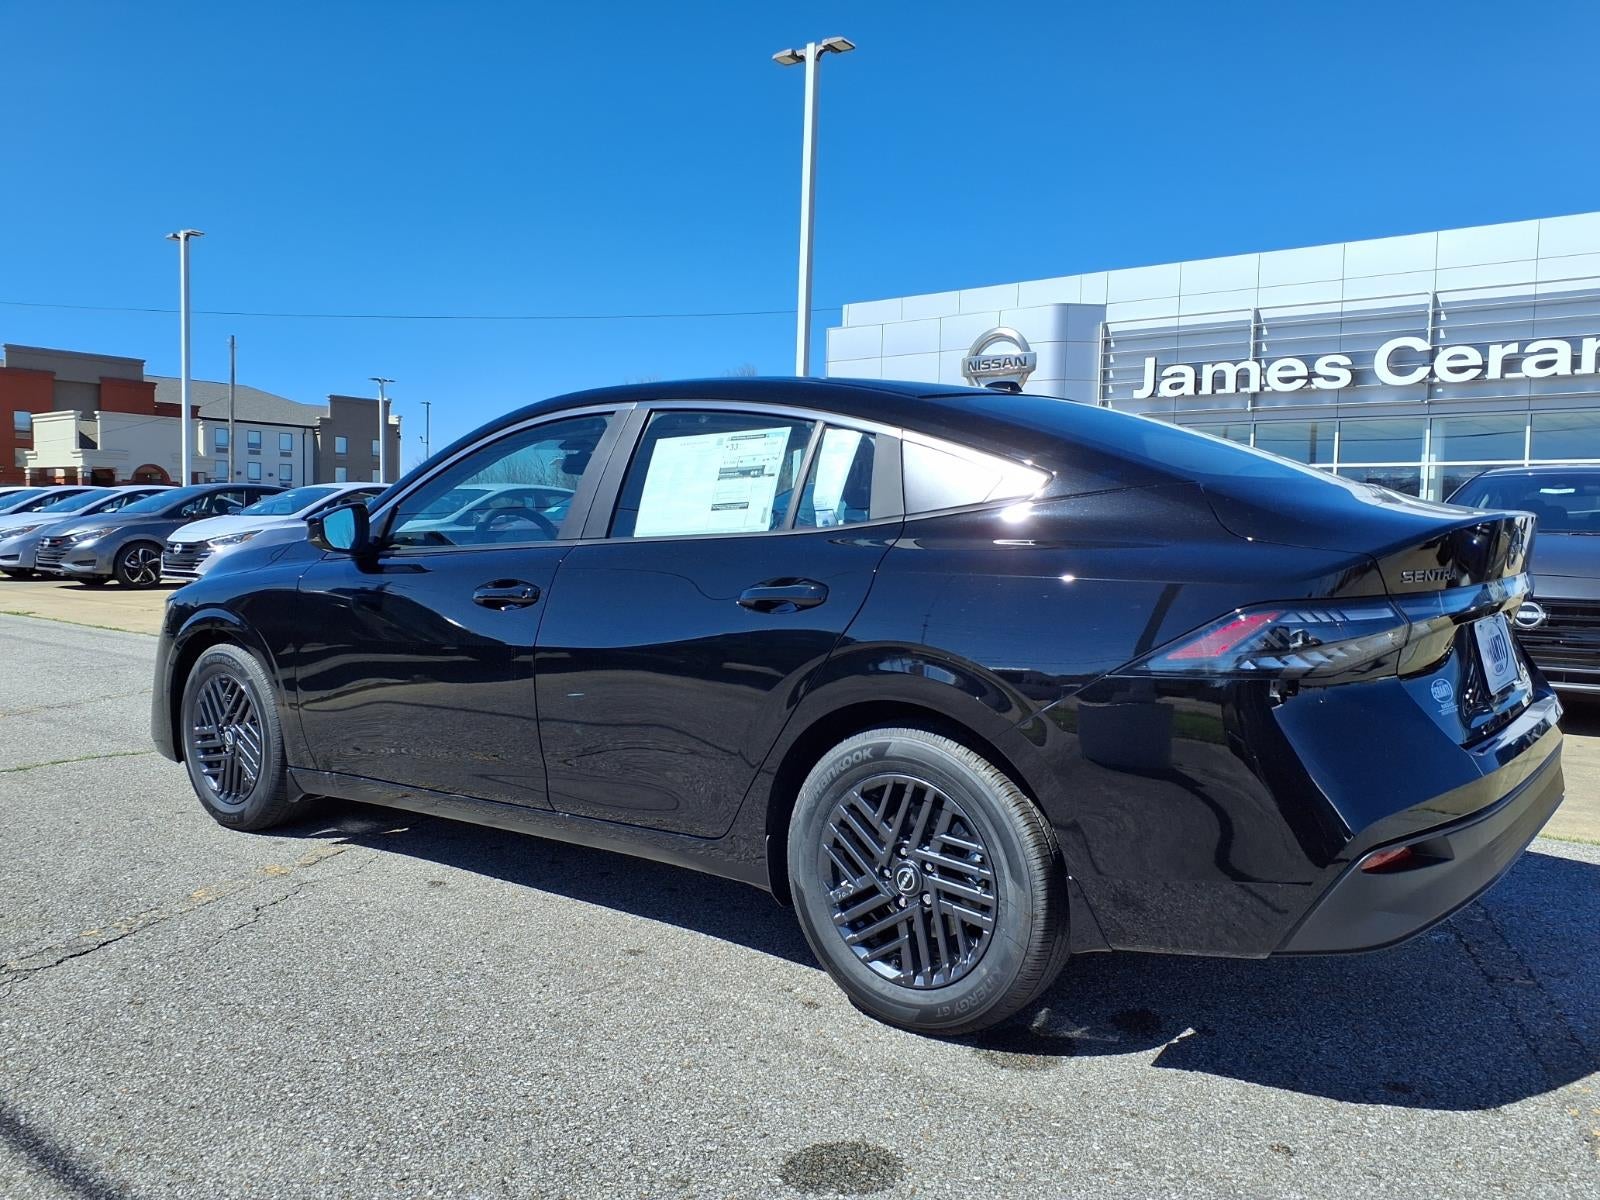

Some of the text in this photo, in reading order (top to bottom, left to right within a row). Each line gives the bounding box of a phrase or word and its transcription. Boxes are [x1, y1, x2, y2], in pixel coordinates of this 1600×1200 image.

[967, 356, 1027, 372] NISSAN
[1132, 354, 1353, 398] James
[1402, 568, 1457, 584] SENTRA
[936, 1006, 951, 1018] GT
